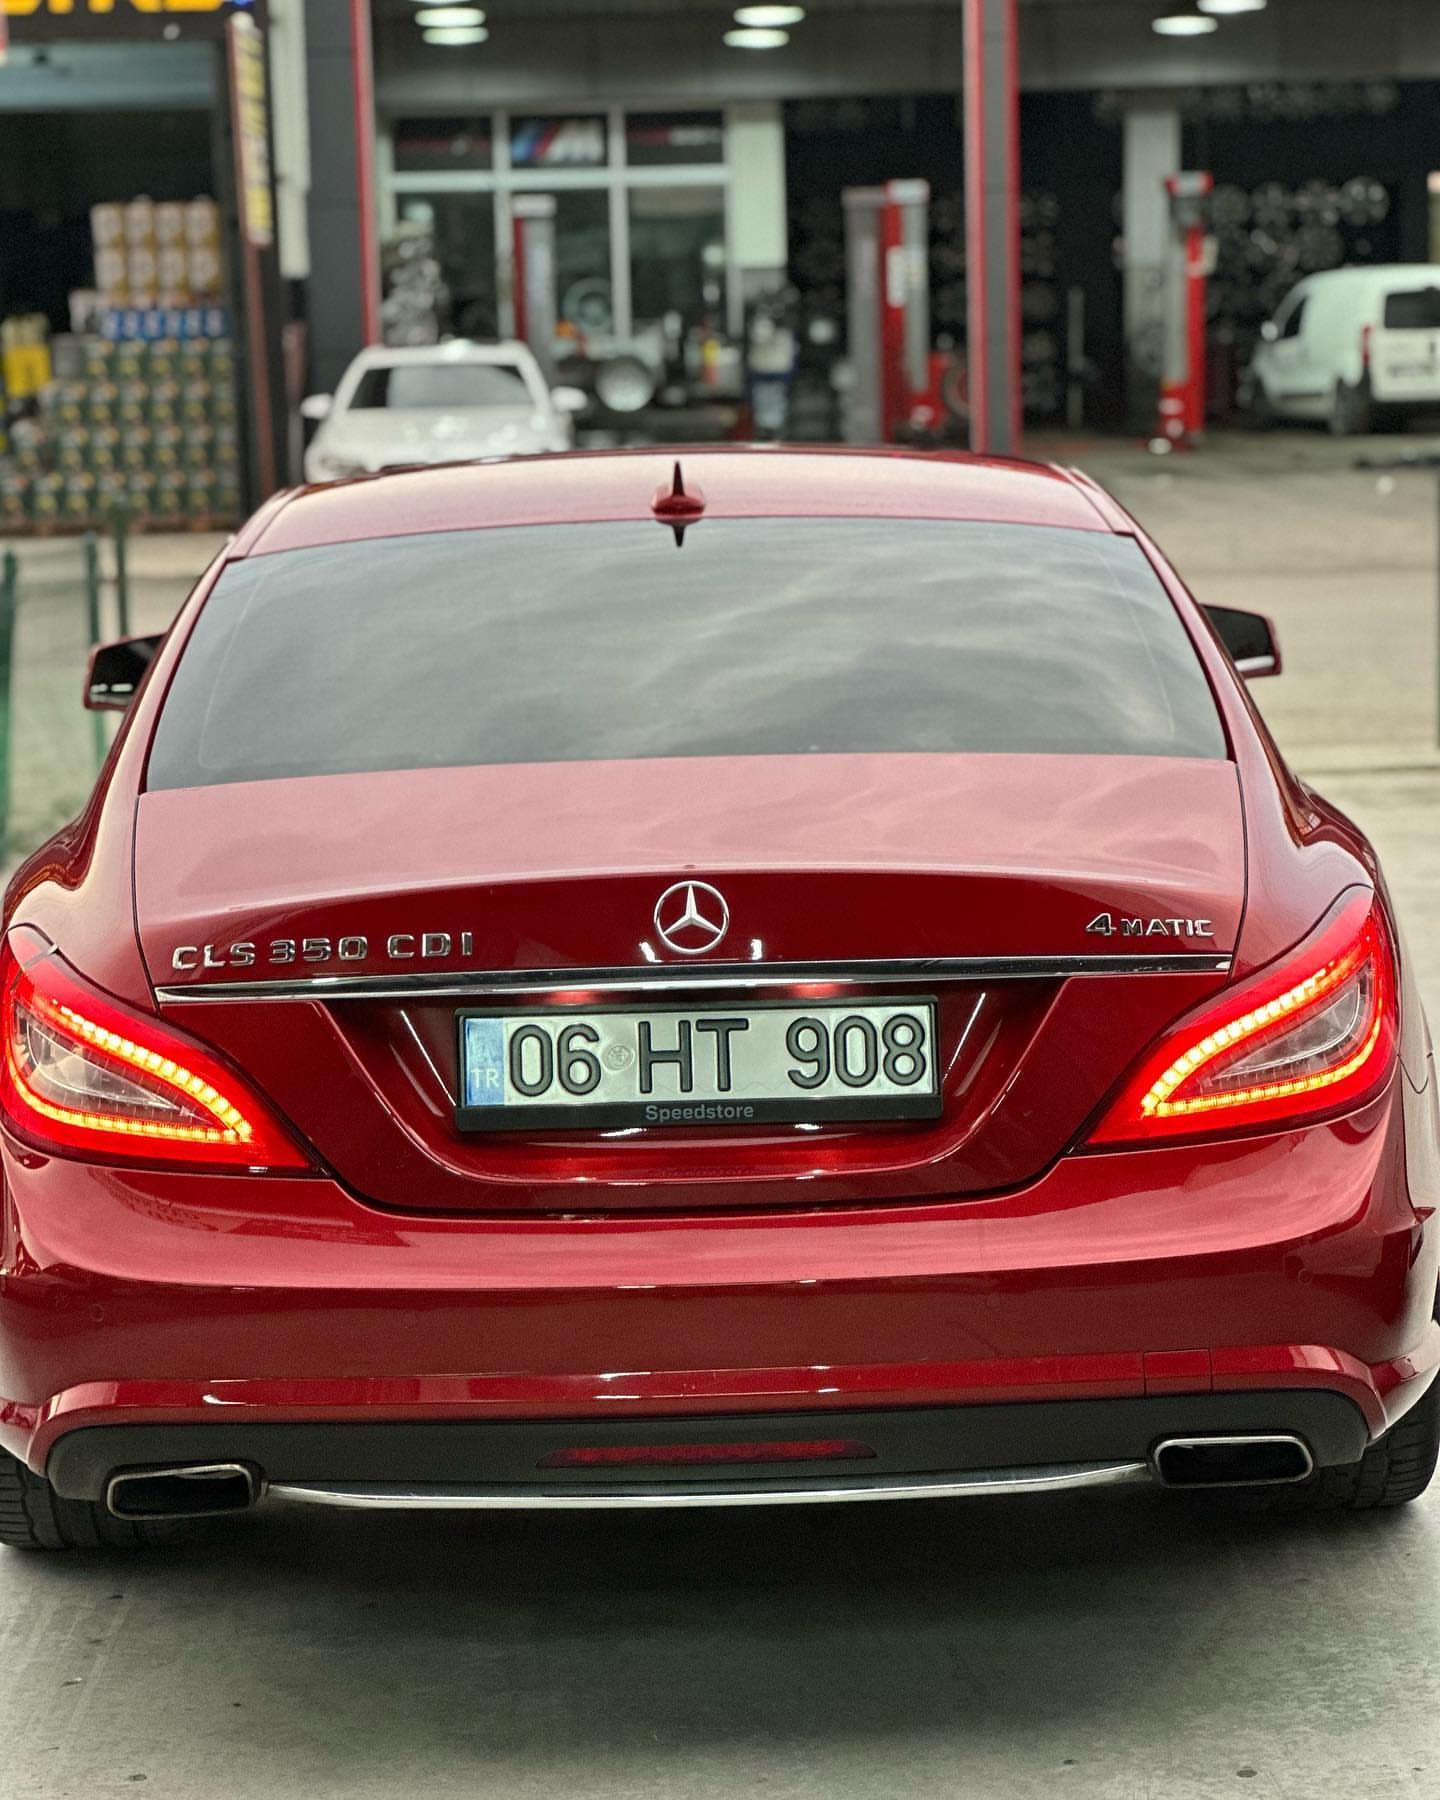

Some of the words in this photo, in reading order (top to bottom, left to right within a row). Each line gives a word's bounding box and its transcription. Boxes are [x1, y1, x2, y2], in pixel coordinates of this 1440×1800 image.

[171, 942, 255, 970] CLS
[268, 936, 368, 963] 350
[387, 931, 473, 959] CDI
[509, 1023, 602, 1097] 06
[638, 1017, 750, 1094] HT
[786, 1015, 927, 1089] 908
[470, 1067, 500, 1089] TR
[645, 1103, 754, 1123] Speedstore
